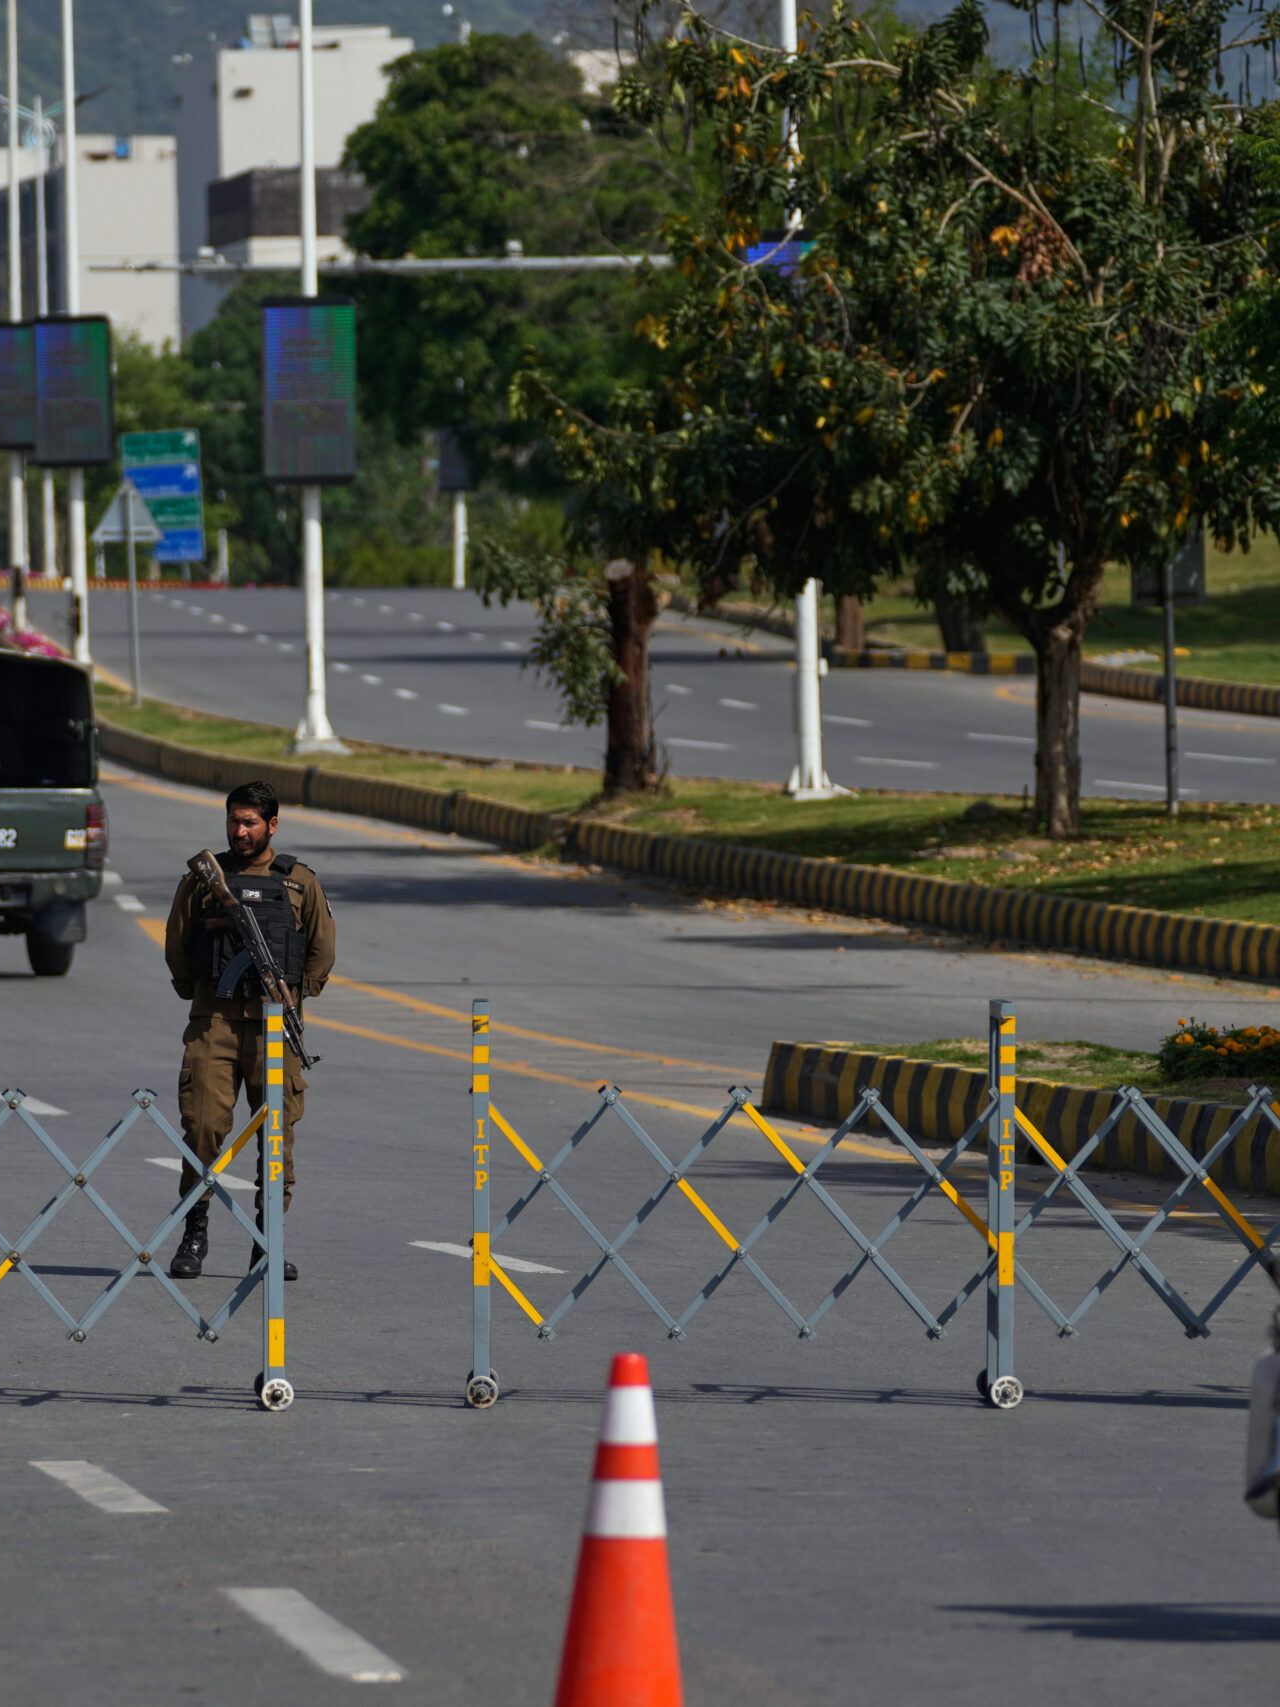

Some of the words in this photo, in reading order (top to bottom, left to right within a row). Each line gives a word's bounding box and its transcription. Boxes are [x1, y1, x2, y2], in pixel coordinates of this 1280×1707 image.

[268, 1109, 284, 1181] ITP
[473, 1119, 490, 1190] ITP
[999, 1119, 1015, 1190] ITP
